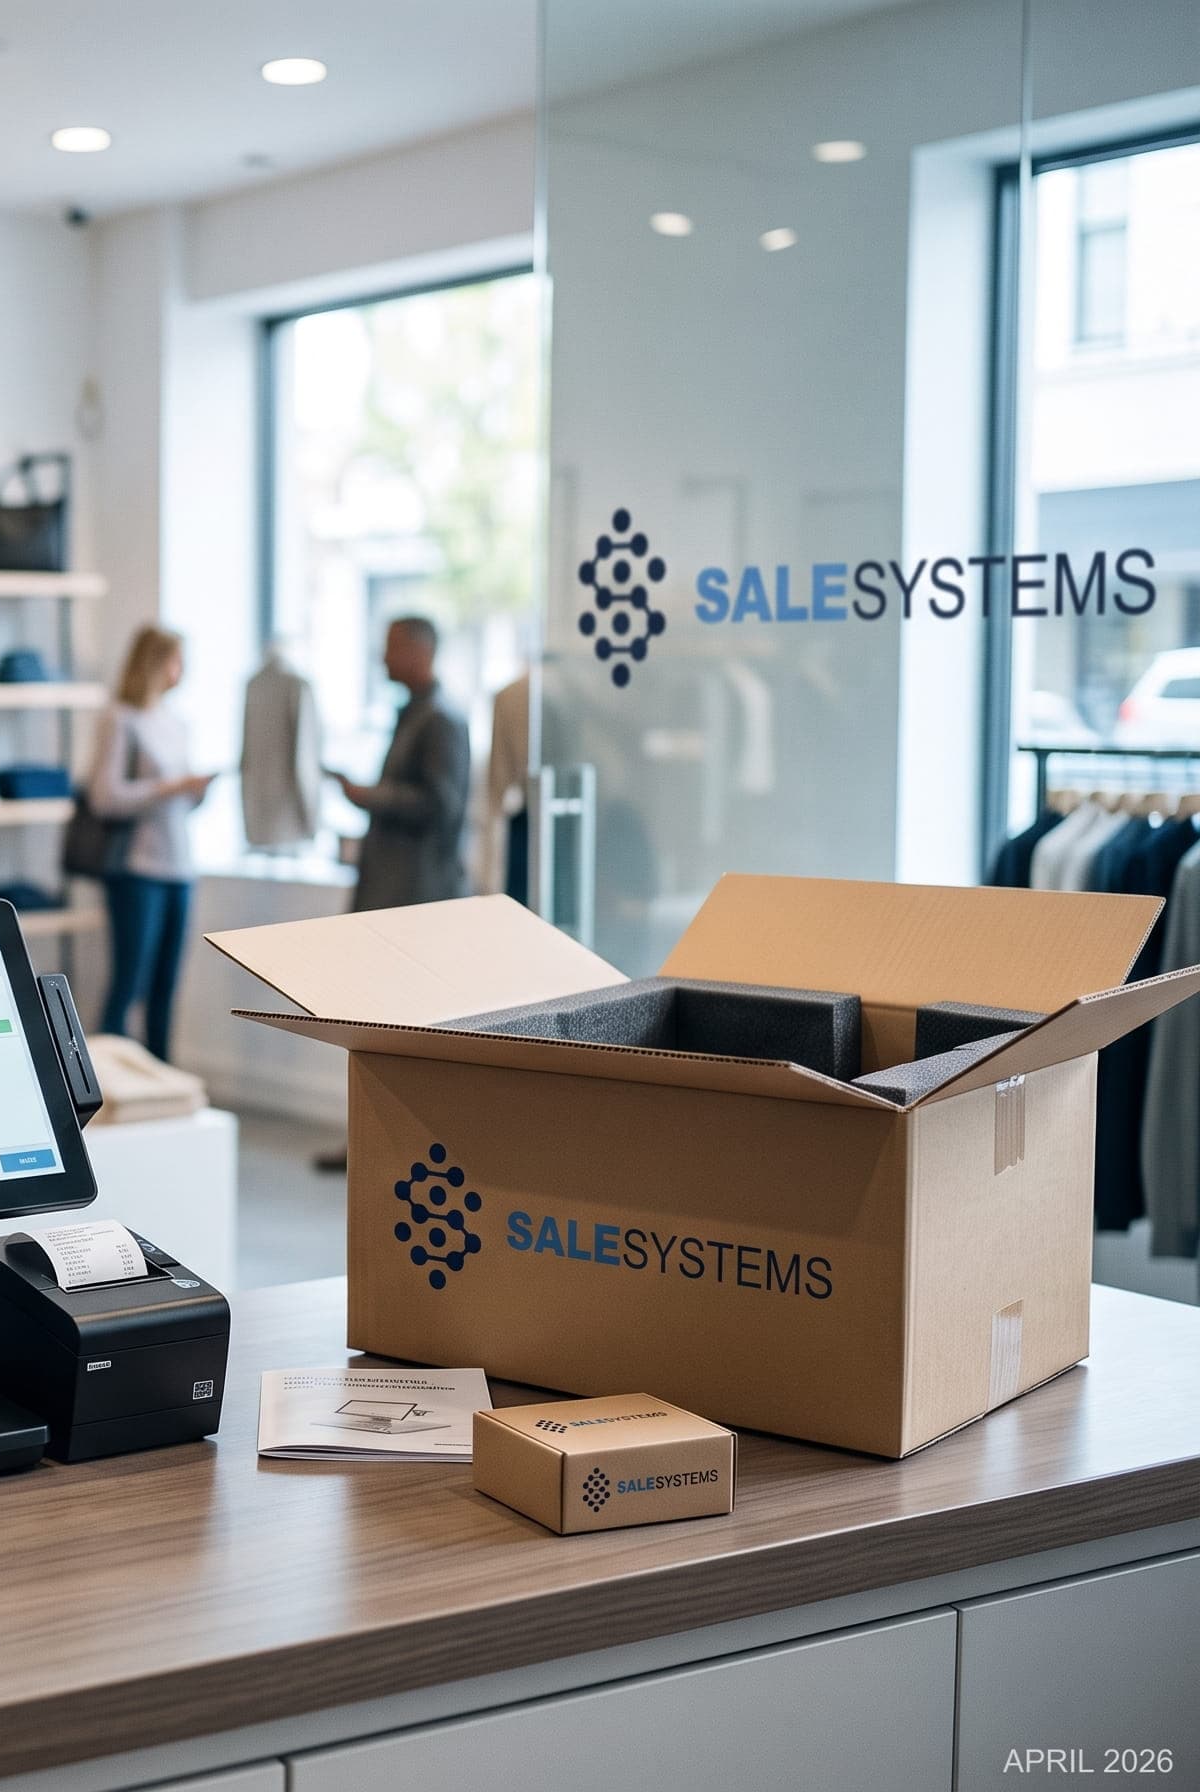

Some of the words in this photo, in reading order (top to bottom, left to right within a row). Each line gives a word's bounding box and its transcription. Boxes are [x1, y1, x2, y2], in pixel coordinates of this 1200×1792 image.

[694, 548, 1157, 624] SALESYSTEMS
[506, 1210, 833, 1300] SALESYSTEMS
[568, 1411, 668, 1428] SALESYSTEMS
[616, 1469, 719, 1494] SALESYSTEMS
